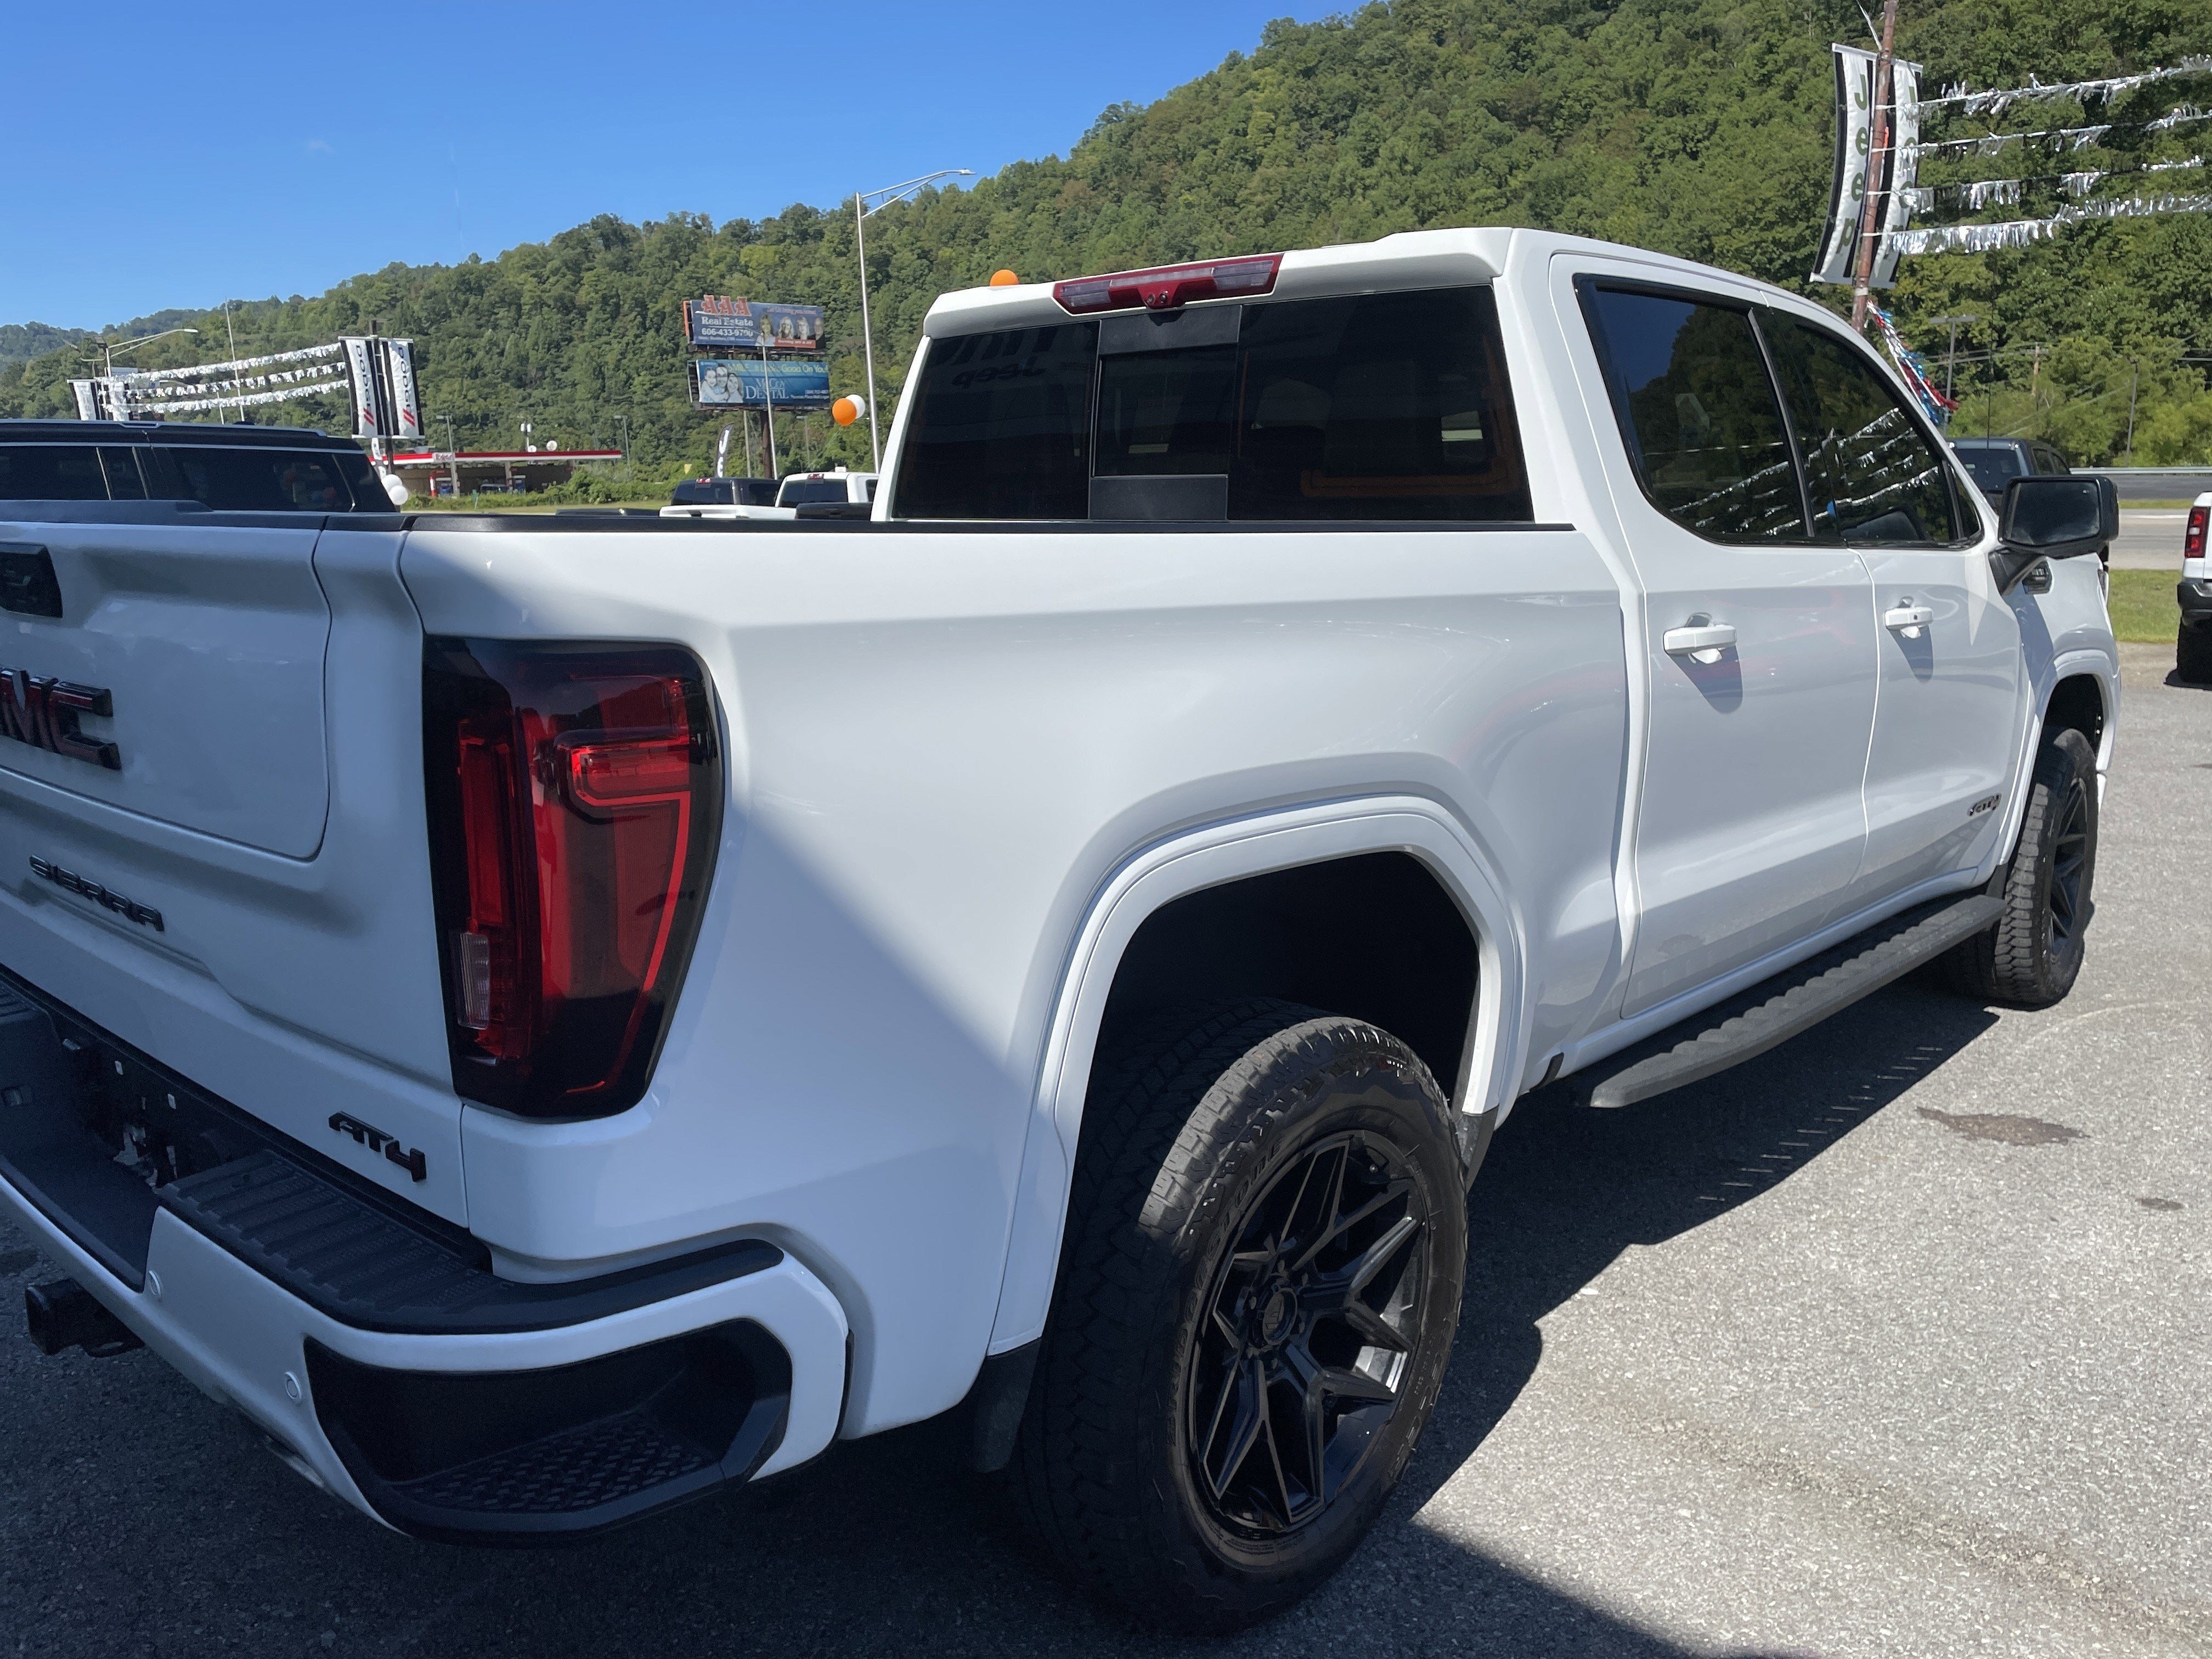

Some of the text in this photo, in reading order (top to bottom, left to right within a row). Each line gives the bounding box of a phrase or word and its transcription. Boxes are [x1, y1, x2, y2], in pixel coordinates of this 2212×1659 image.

[1837, 74, 1867, 254] Jeep
[701, 294, 752, 317] AAA
[702, 317, 753, 326] Real Estate
[0, 668, 122, 770] MC
[29, 854, 165, 932] SIERRA
[328, 1110, 427, 1182] AT4
